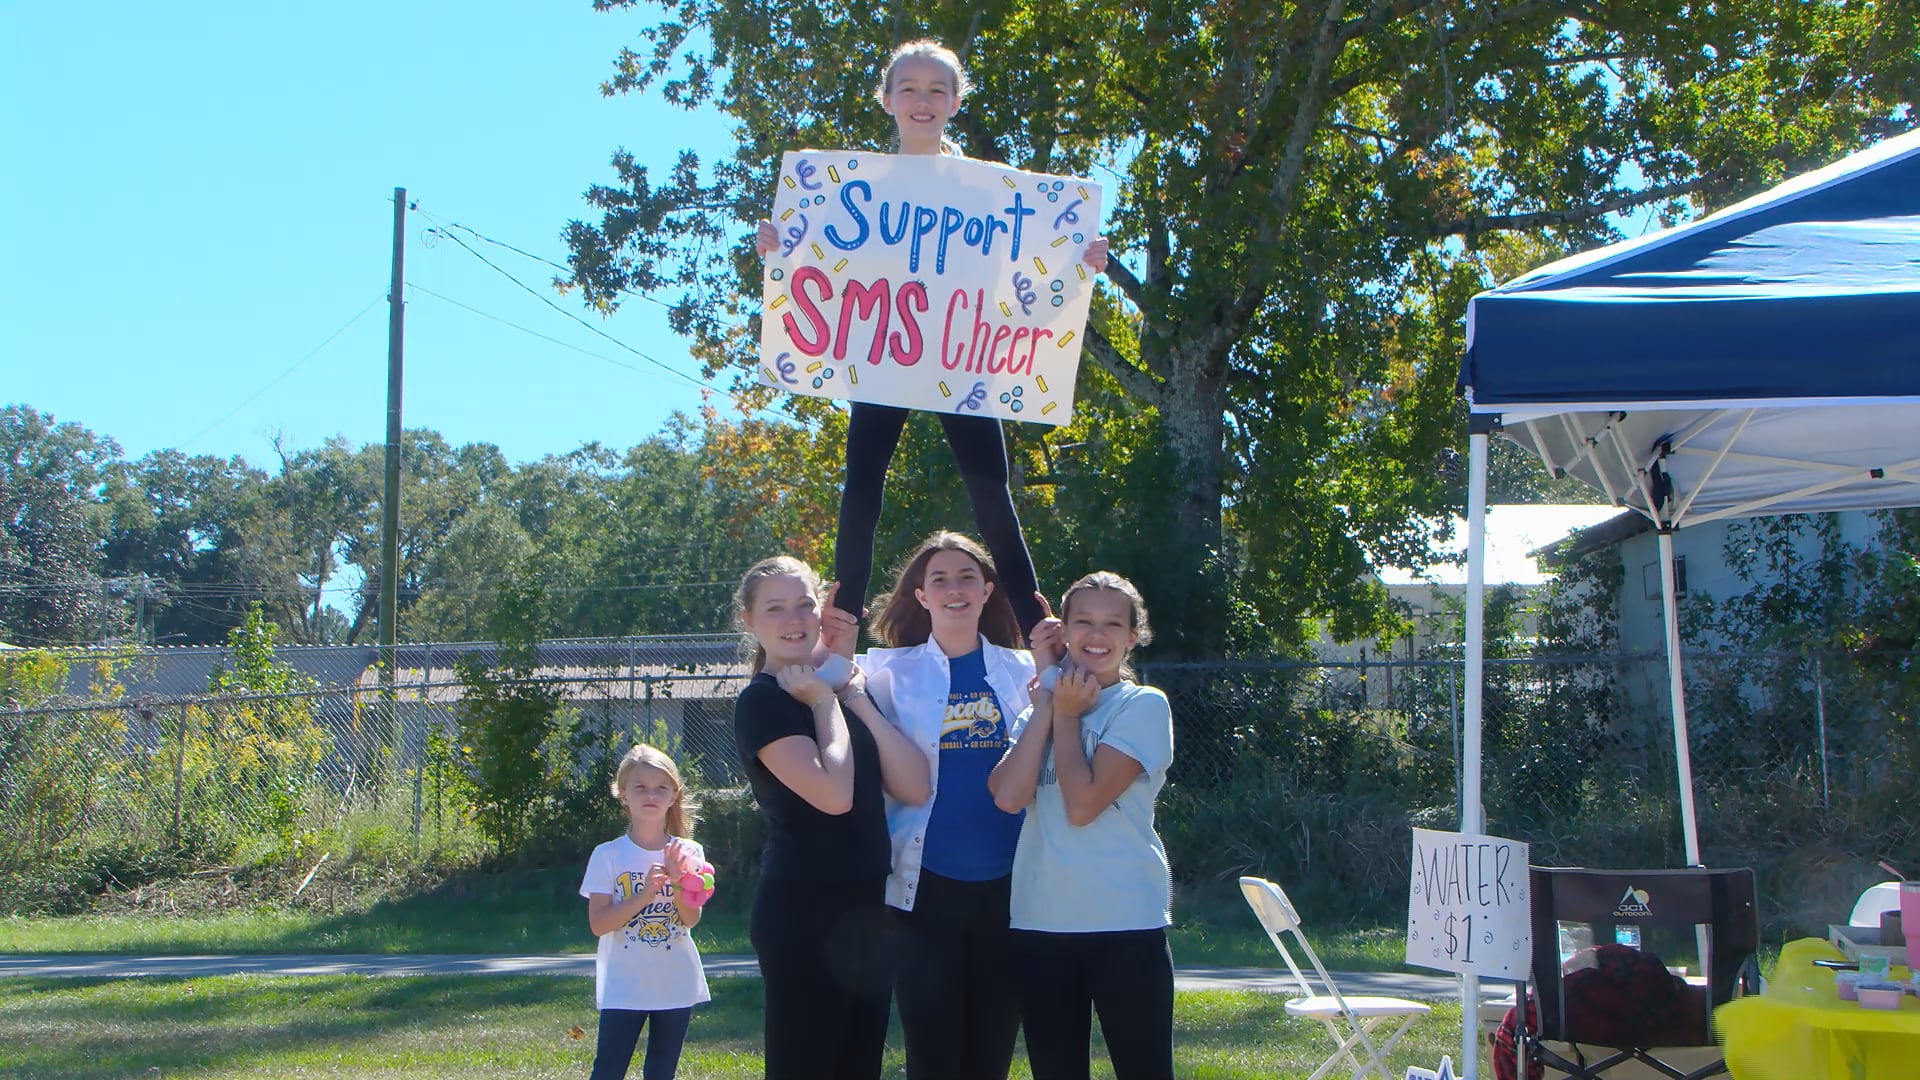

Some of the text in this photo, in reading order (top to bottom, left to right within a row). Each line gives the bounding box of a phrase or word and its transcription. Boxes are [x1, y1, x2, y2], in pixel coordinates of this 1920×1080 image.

[824, 180, 1036, 275] Support
[781, 265, 1054, 376] SMS Cheer
[1418, 843, 1511, 906] WATER
[1443, 911, 1475, 964] $1
